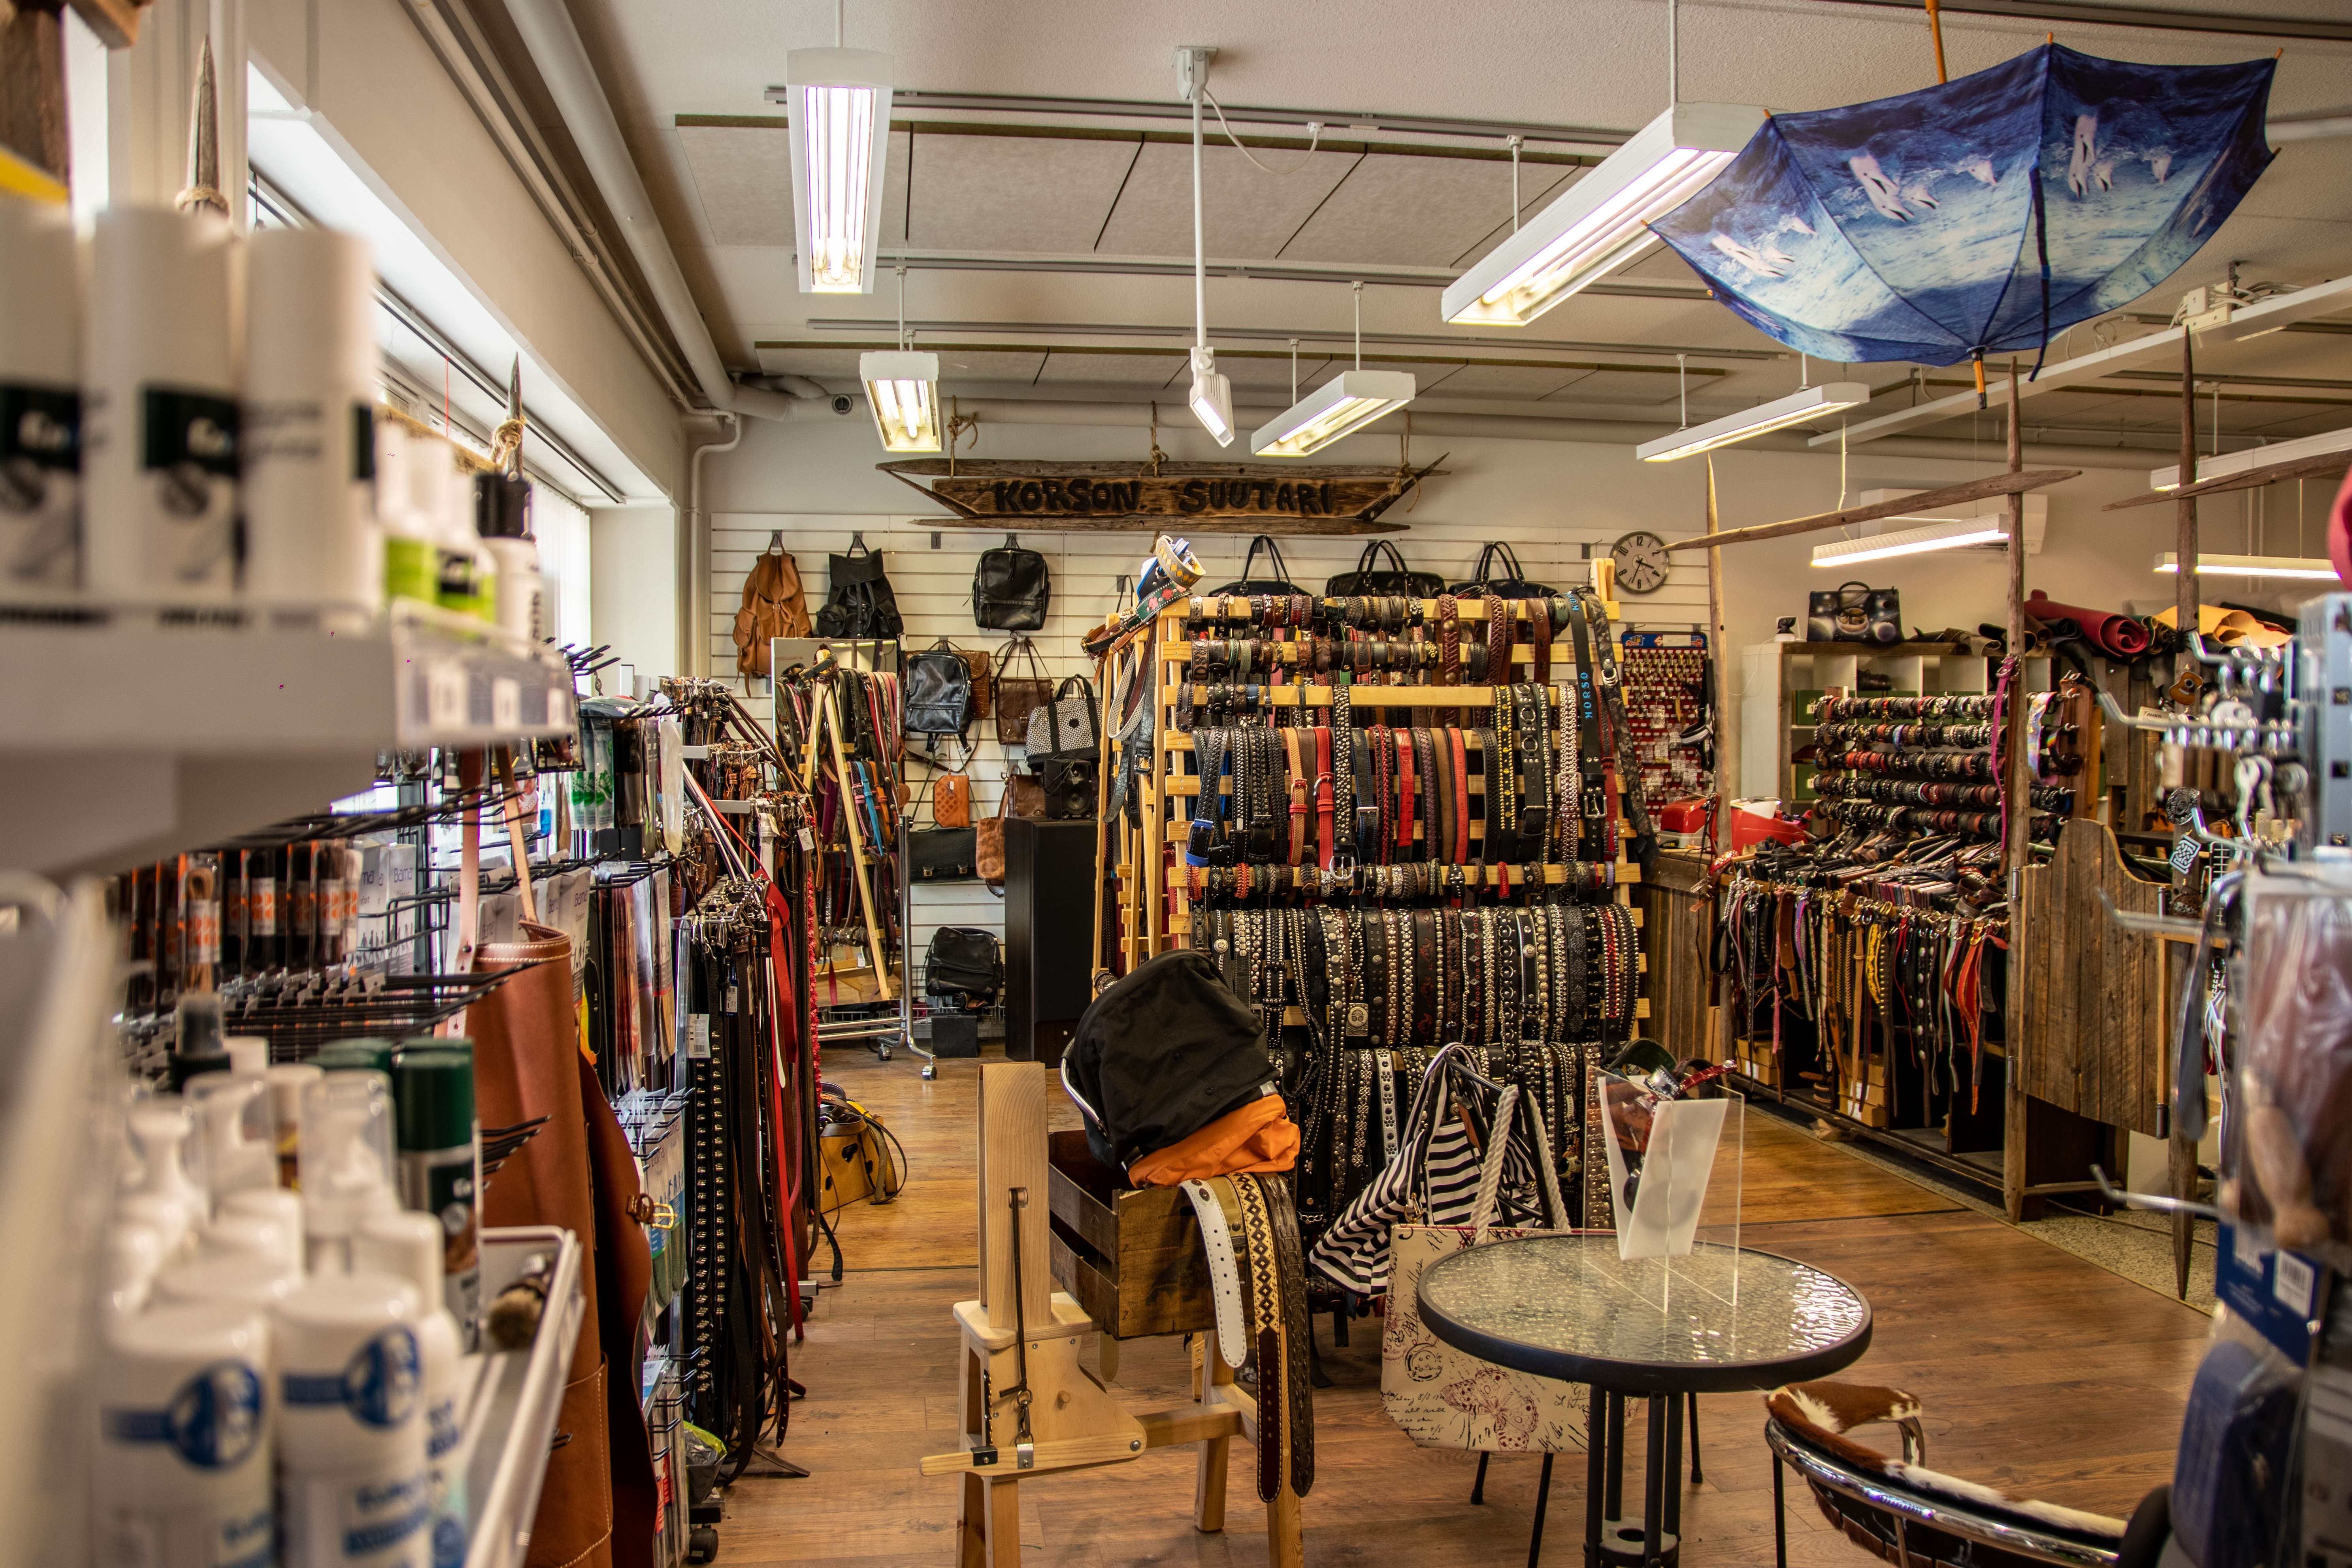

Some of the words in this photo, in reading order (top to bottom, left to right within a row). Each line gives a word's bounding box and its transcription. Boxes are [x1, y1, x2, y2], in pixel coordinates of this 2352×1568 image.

[995, 479, 1142, 512] KORSON
[1179, 481, 1332, 514] SUUTARI
[1637, 536, 1643, 546] 12
[1619, 546, 1629, 556] 10
[1637, 579, 1642, 588] 6
[1581, 672, 1593, 719] KORSO
[394, 868, 413, 883] Bama
[574, 890, 588, 907] Bama
